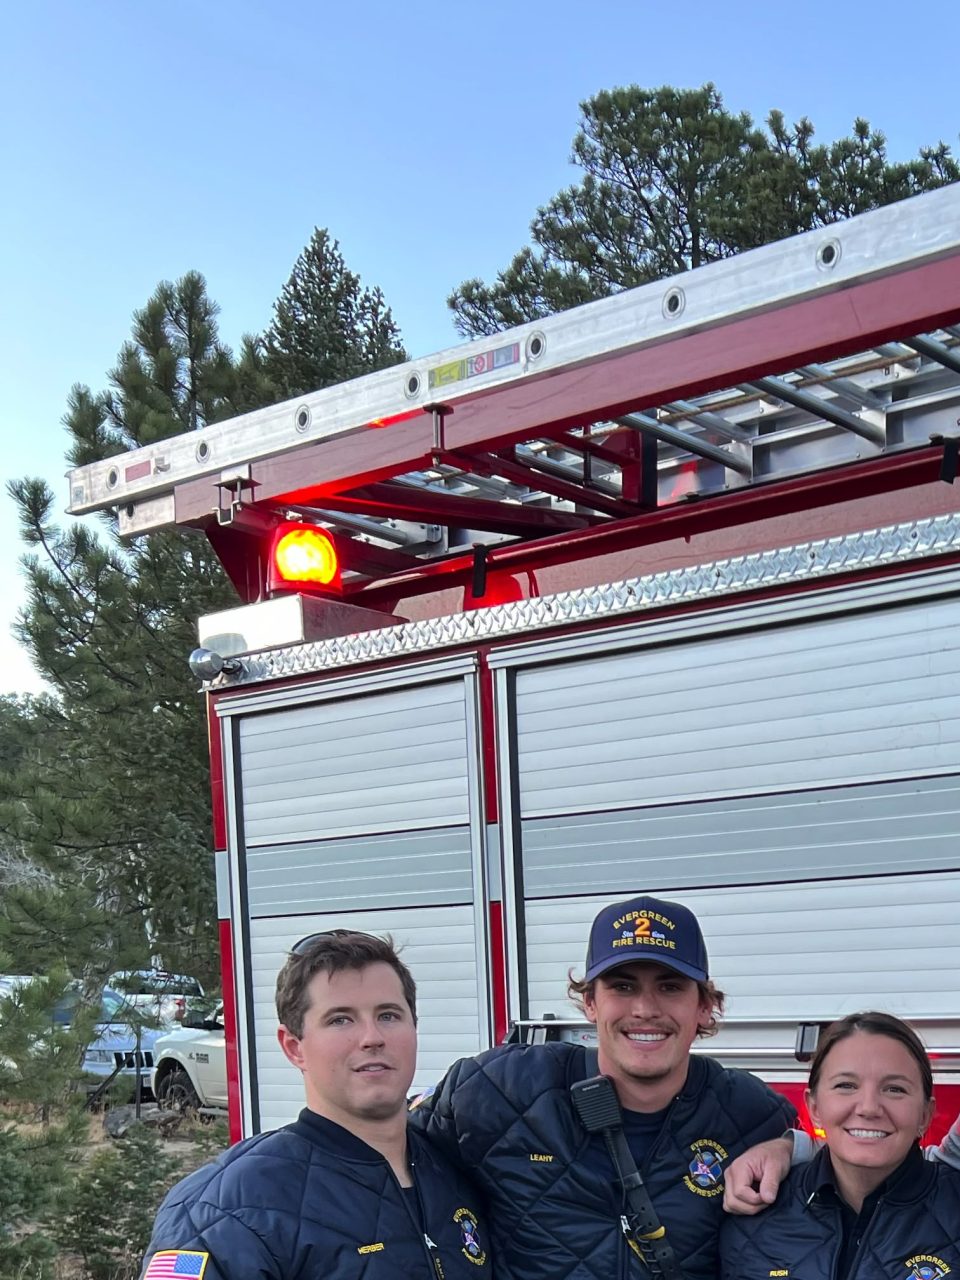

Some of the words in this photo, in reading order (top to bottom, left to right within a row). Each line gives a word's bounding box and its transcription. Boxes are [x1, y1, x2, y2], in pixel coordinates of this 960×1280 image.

[612, 910, 676, 930] EVERGREEN
[634, 918, 651, 936] 2
[612, 937, 634, 948] FIRE
[636, 937, 676, 949] RESCUE
[530, 1153, 554, 1162] LEAHY
[690, 1139, 729, 1159] EVERGREEN
[905, 1254, 952, 1274] EVERGREEN
